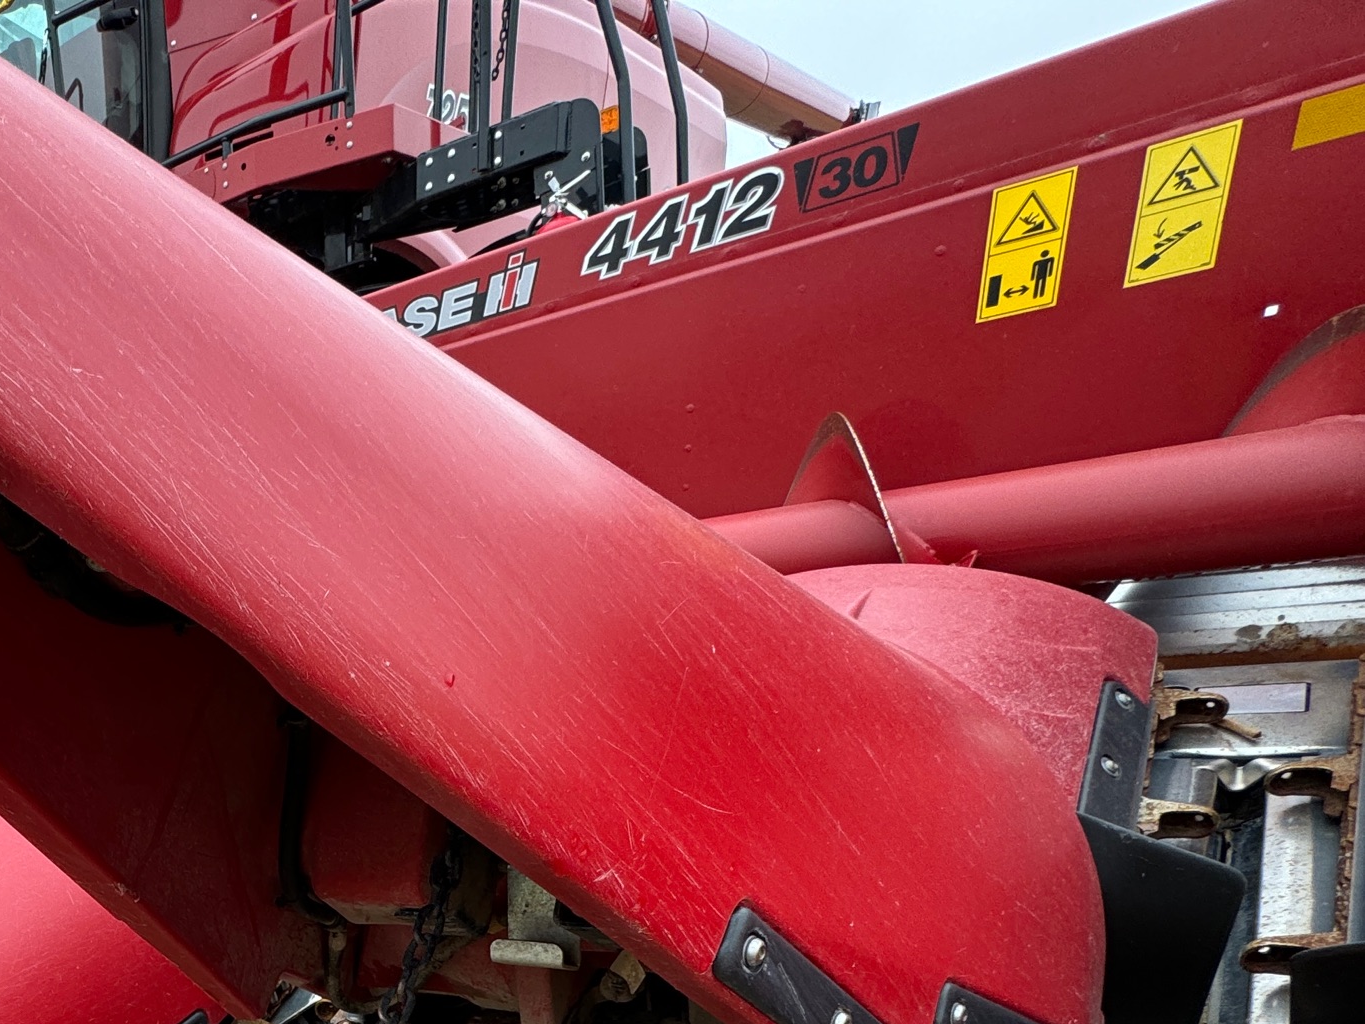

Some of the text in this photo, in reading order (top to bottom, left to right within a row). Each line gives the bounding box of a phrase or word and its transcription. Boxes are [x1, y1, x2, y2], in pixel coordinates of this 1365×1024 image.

[818, 145, 888, 199] 30
[580, 165, 786, 281] 4412
[383, 279, 479, 338] SE
